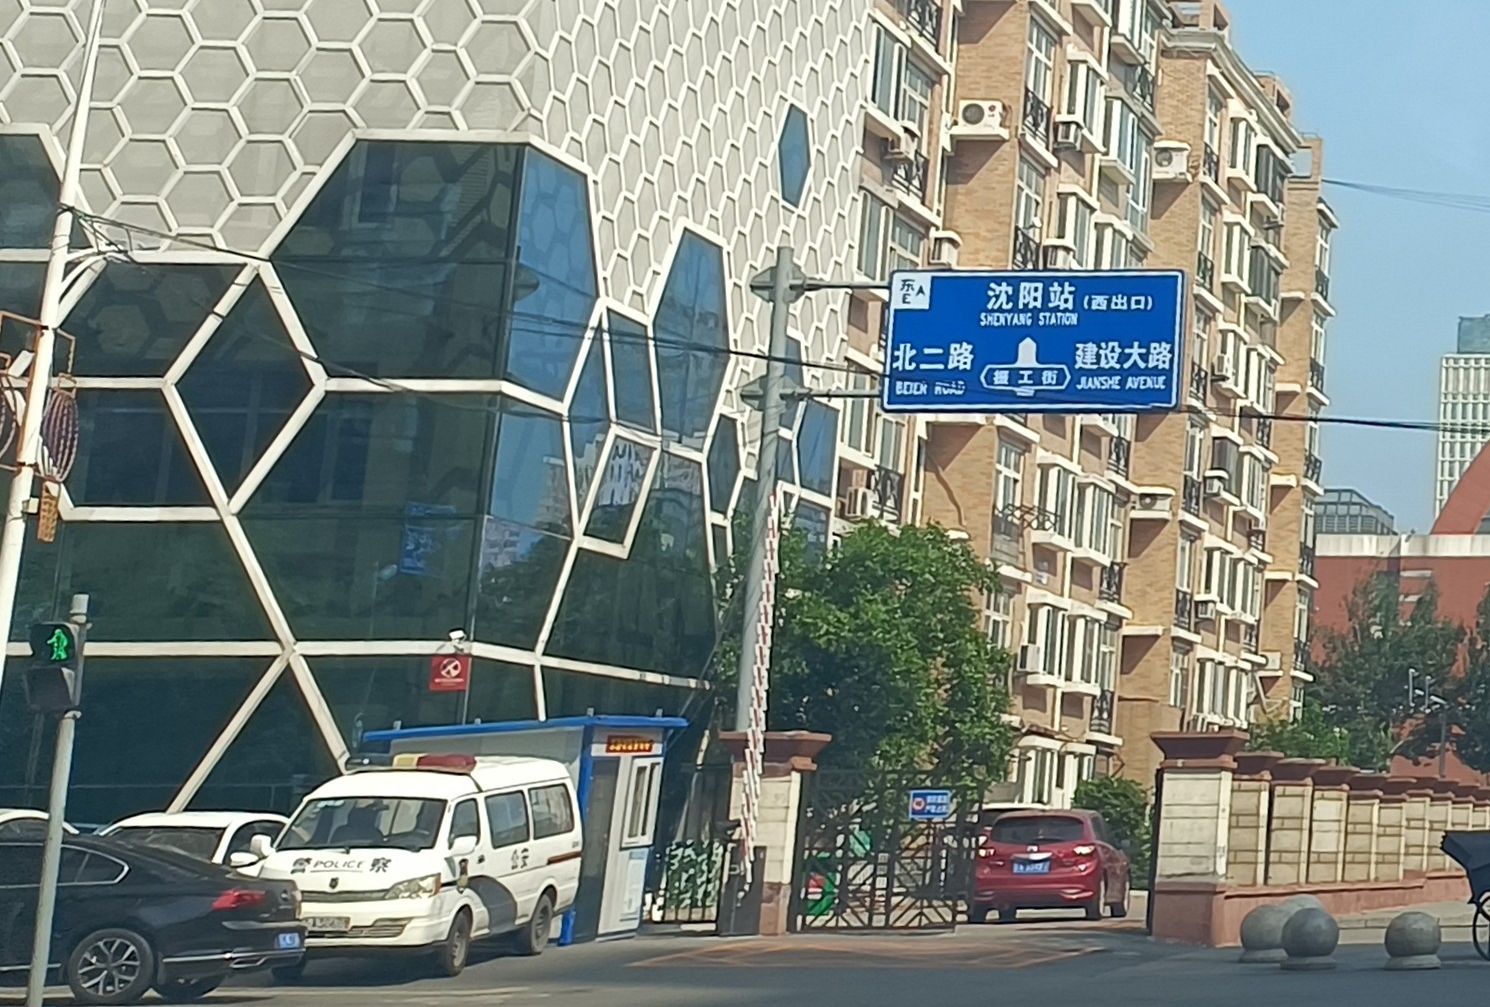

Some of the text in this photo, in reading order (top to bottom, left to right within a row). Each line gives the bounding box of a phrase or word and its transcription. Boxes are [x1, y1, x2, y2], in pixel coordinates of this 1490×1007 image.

[900, 279, 916, 292] 东
[902, 293, 912, 304] E
[986, 281, 1076, 311] 沈阳站
[980, 312, 1078, 327] SHENYANG STATION
[892, 342, 974, 372] 北二路
[1074, 341, 1173, 370] 建设大路
[1076, 375, 1167, 390] JIANSHE AVENUE
[312, 859, 366, 870] POLICE
[369, 856, 393, 874] 察
